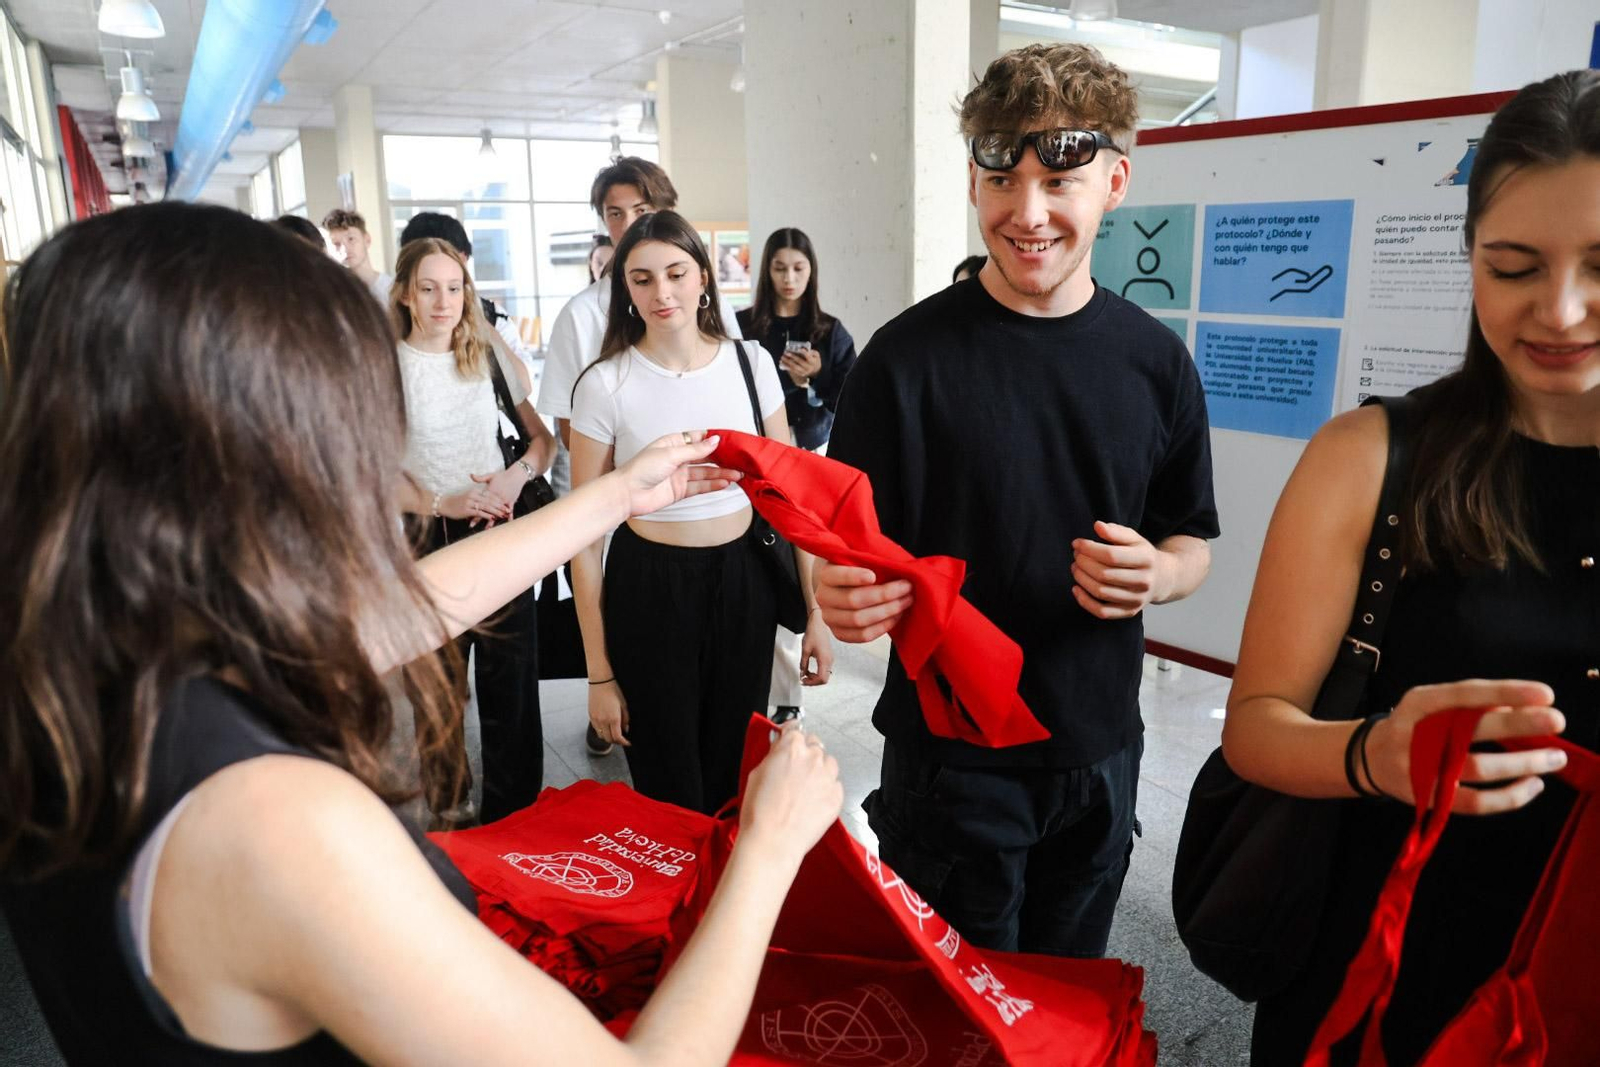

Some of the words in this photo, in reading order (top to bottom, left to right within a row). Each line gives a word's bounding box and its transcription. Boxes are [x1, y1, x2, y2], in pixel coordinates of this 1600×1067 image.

[1216, 217, 1228, 227] ¿A
[1230, 216, 1255, 226] quién
[1258, 216, 1294, 226] protege
[1298, 215, 1320, 223] este
[1401, 225, 1427, 233] puedo
[1215, 230, 1263, 240] protocolo?
[1266, 229, 1302, 240] ¿Dónde
[1306, 230, 1311, 239] y
[1374, 237, 1414, 245] pasando?
[1233, 244, 1258, 254] quién
[1261, 245, 1288, 254] tengo
[1291, 244, 1308, 253] que
[1214, 257, 1247, 265] hablar?
[1260, 336, 1288, 346] protege
[1215, 353, 1252, 361] Universidad
[1268, 356, 1293, 364] Huelva
[1255, 366, 1286, 374] personal
[1268, 376, 1303, 385] proyectos
[1237, 383, 1265, 391] persona
